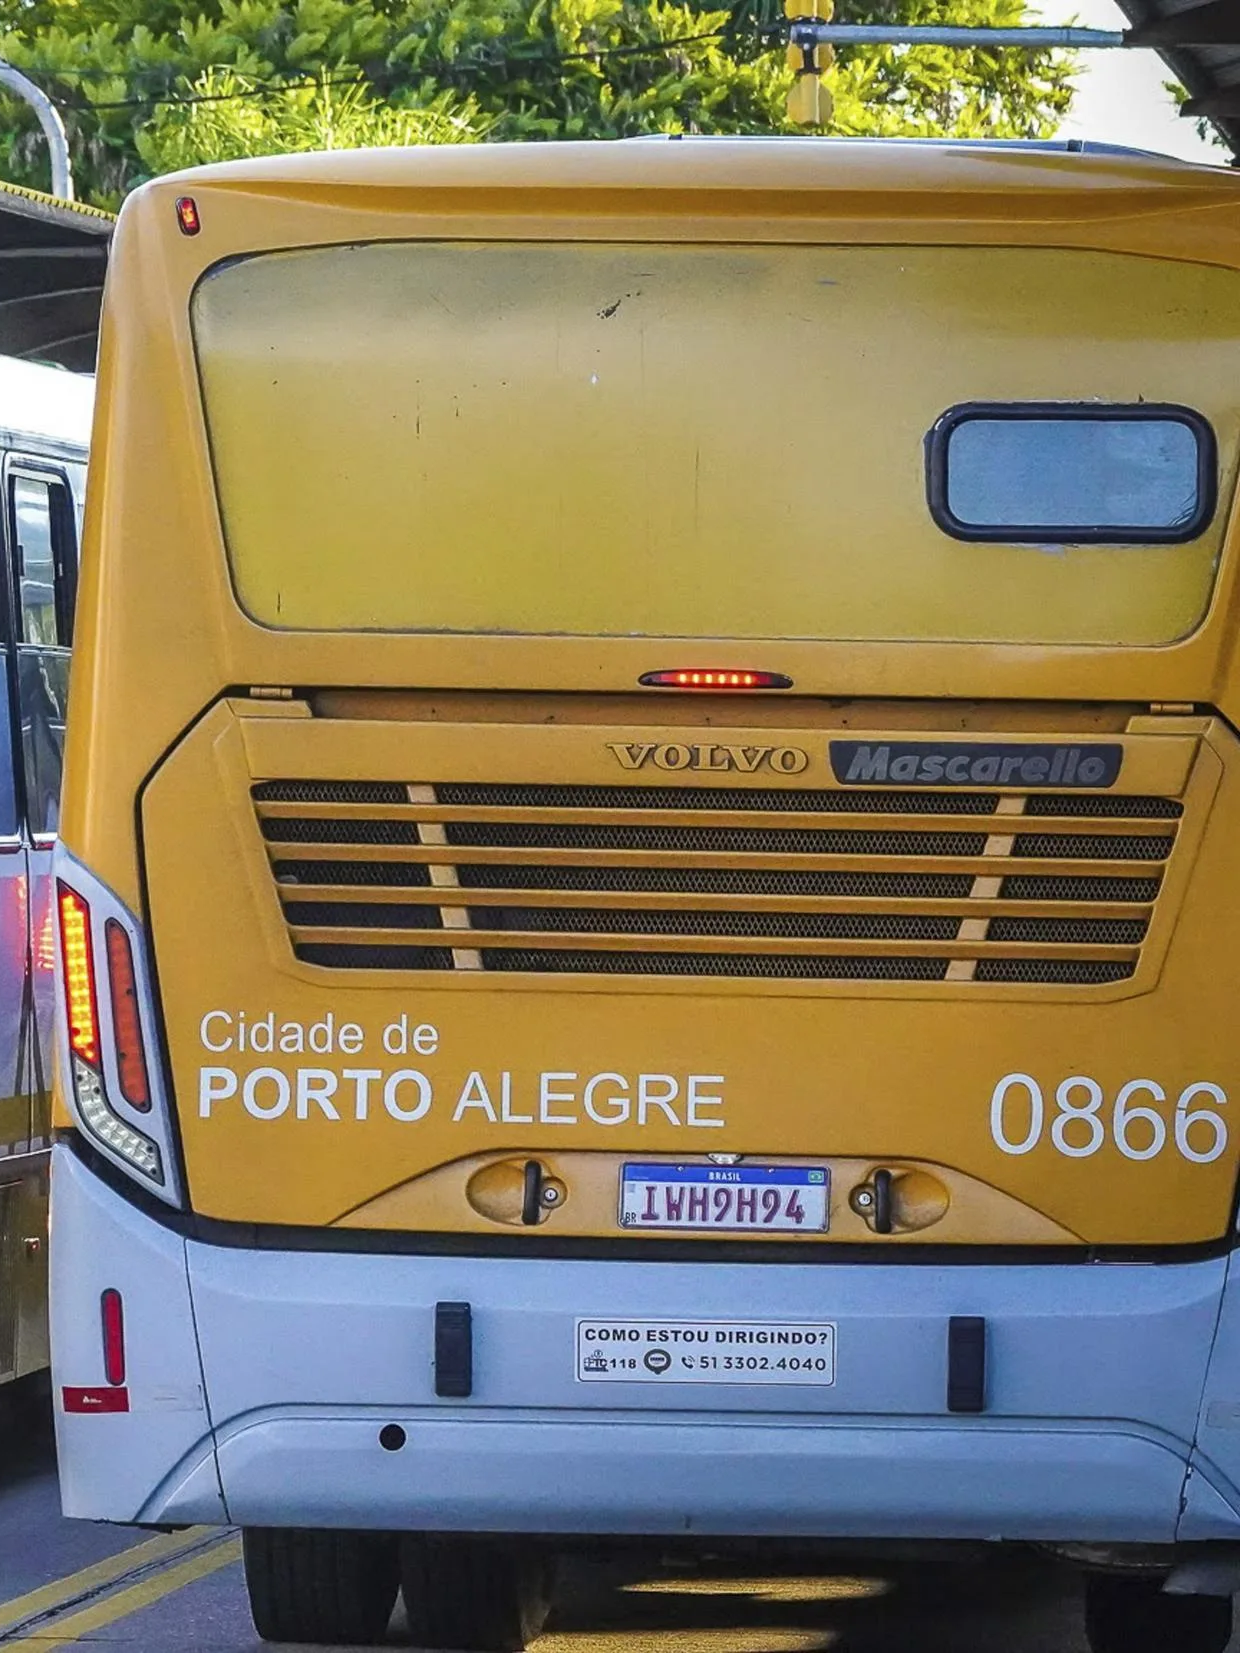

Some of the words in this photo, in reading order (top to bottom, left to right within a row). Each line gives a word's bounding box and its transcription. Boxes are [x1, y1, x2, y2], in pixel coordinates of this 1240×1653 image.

[606, 743, 809, 774] VOLVO
[845, 746, 1106, 784] Mascarello
[199, 1010, 364, 1054] Cidade
[382, 1013, 439, 1055] de
[199, 1066, 433, 1122] PORTO
[452, 1071, 725, 1127] ALEGRE
[990, 1072, 1228, 1164] 0866
[709, 1171, 741, 1182] BRASIL
[624, 1211, 637, 1224] BR
[640, 1185, 806, 1225] IWH9H94
[585, 1328, 640, 1341] COMO
[646, 1330, 709, 1343] ESTOU
[715, 1331, 828, 1345] DIRIGINDO?
[609, 1358, 637, 1370] 118
[700, 1356, 717, 1369] 51
[723, 1356, 826, 1371] 3302.4040
